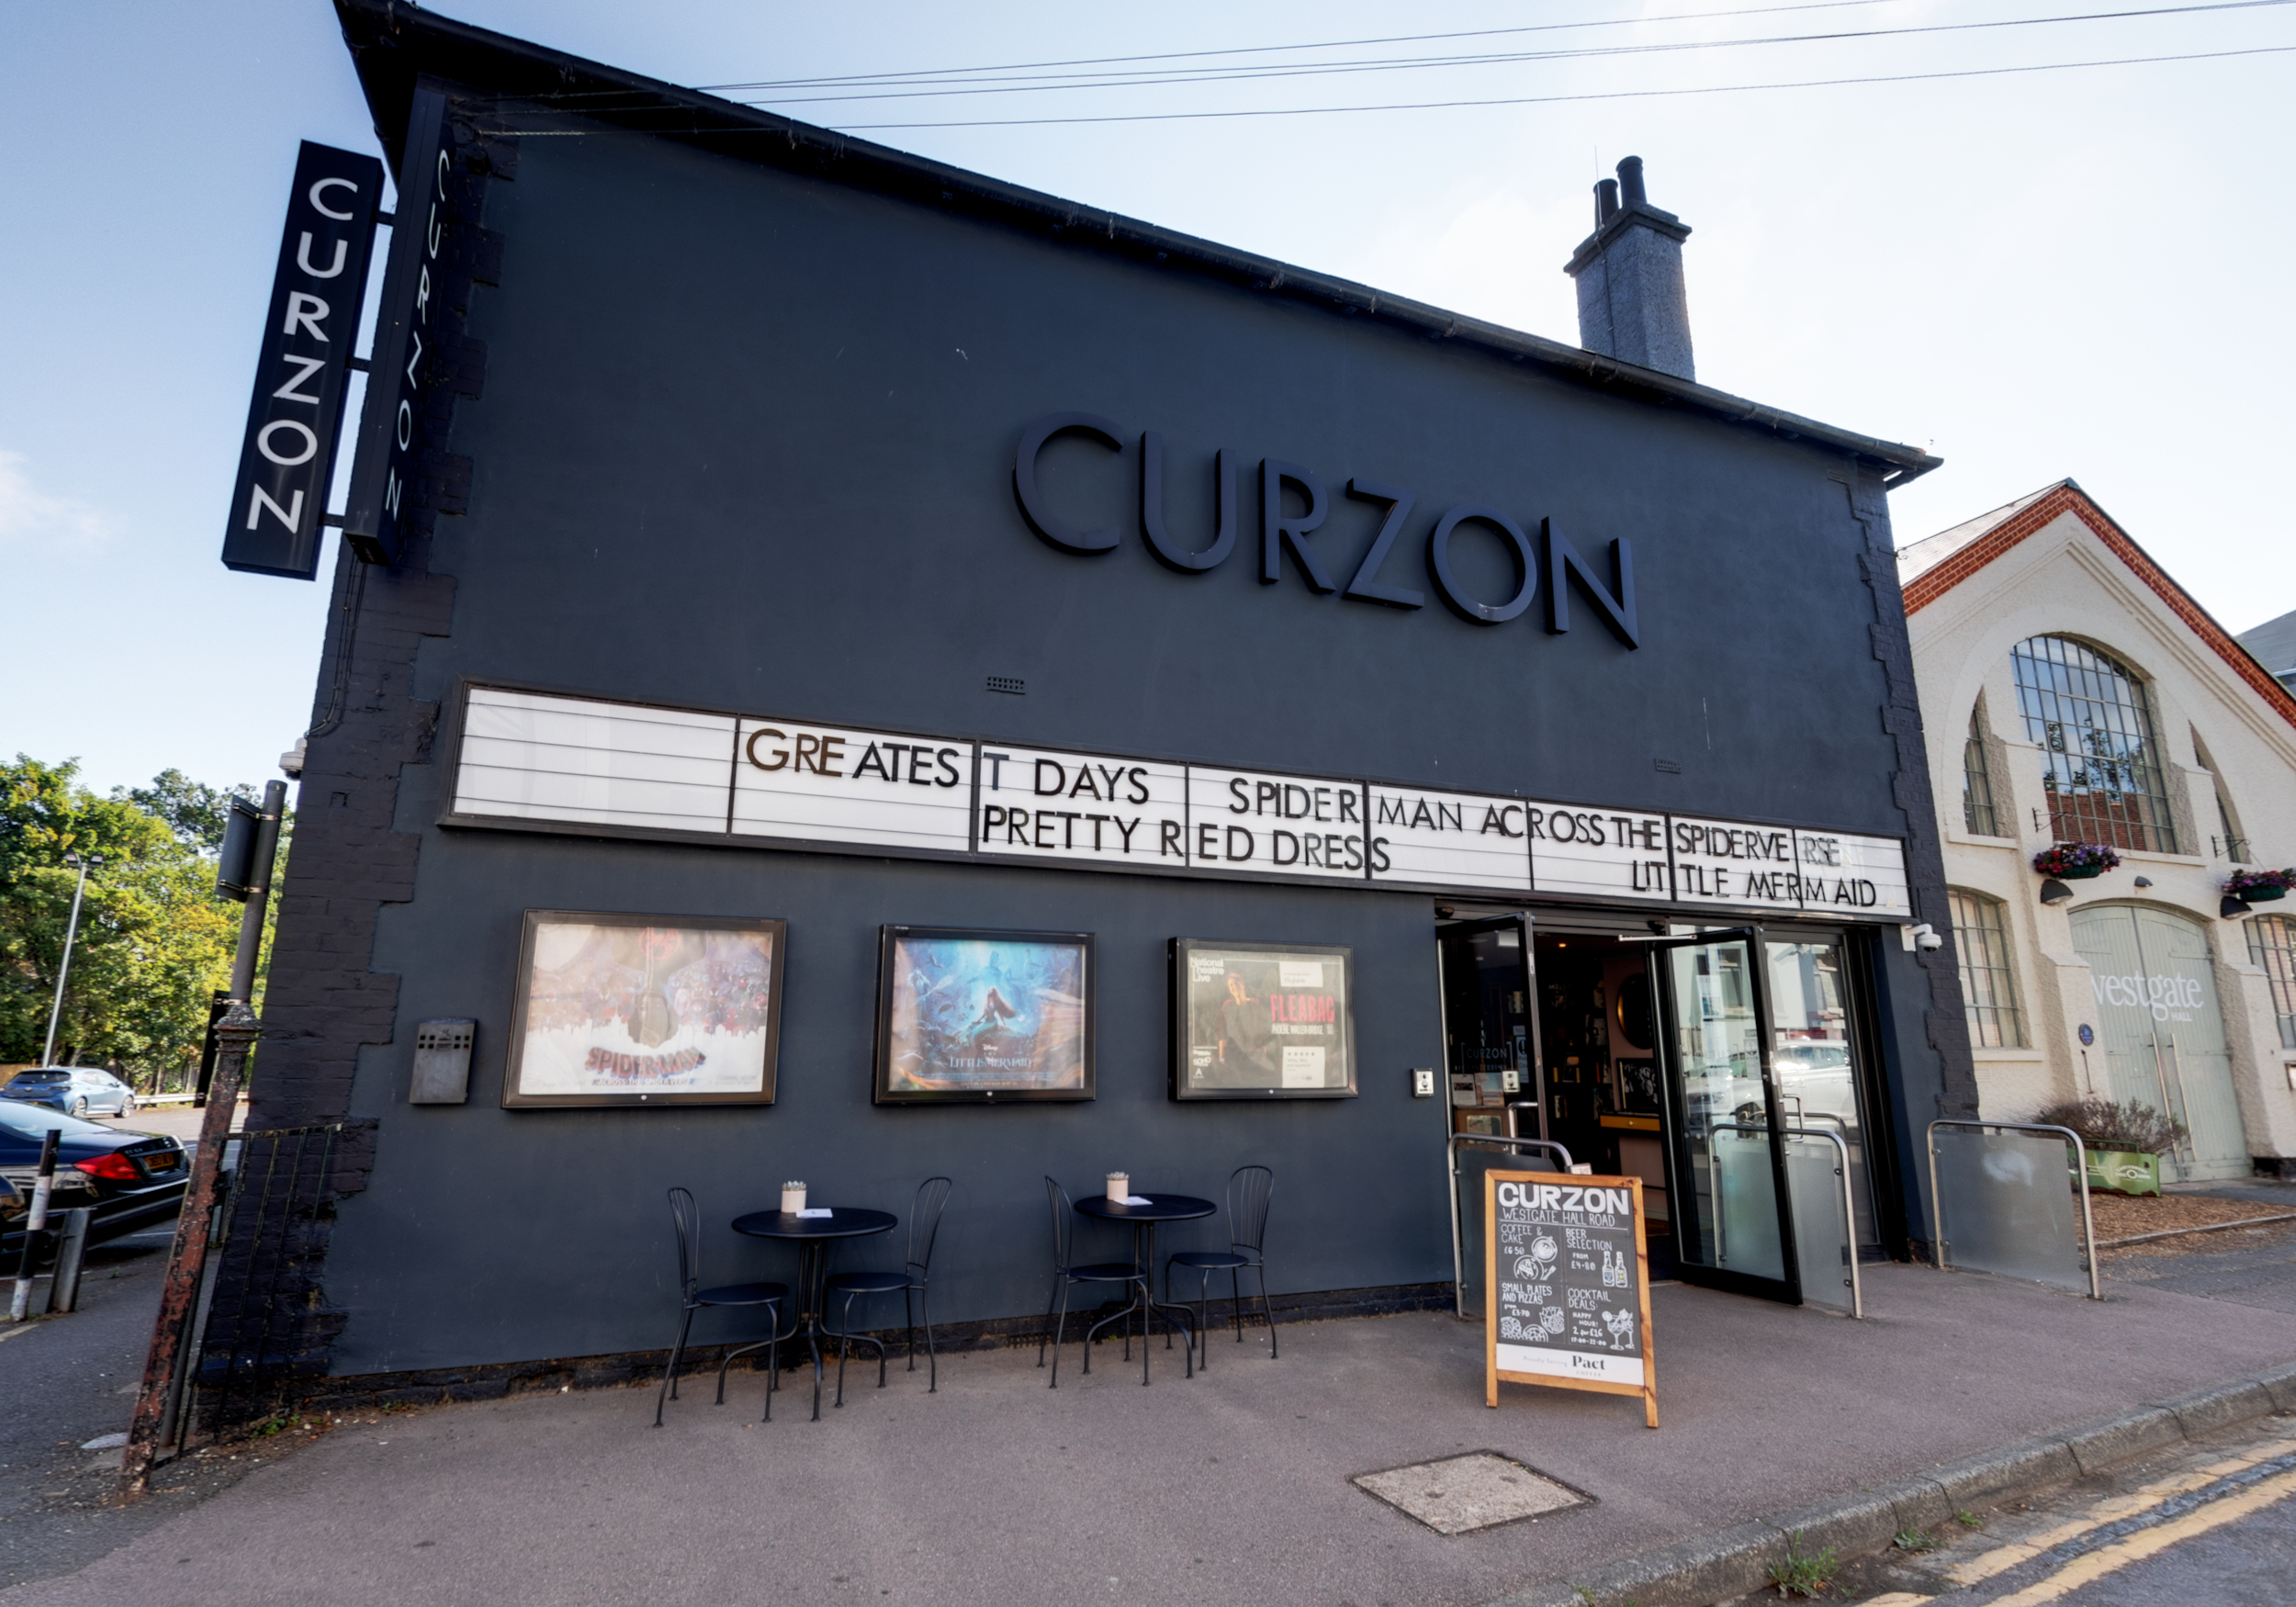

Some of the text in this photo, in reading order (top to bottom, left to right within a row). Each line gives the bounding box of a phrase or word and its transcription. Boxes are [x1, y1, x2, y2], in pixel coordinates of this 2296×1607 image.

[386, 150, 450, 522] CURZON
[246, 177, 358, 534] CURZON
[1012, 410, 1639, 652] CURZON
[1034, 758, 1150, 805] DAYS
[1229, 777, 1361, 824] SPIDER
[1378, 793, 1462, 833] MAN
[1480, 804, 1605, 847] ACROSS
[1610, 816, 1663, 851] THE
[983, 804, 1142, 854] PRETTY
[1161, 818, 1255, 862] RED
[1272, 829, 1392, 872] DRESS
[1190, 957, 1224, 967] National
[1191, 966, 1224, 975] Theatre
[1192, 974, 1211, 983] Live
[1269, 994, 1335, 1023] FLEABAG
[1466, 1047, 1508, 1060] CURZON
[585, 1045, 706, 1079] SPIDER-MAN
[1498, 1182, 1629, 1216] CURZON
[1503, 1208, 1615, 1227] WESTGATE HALL ROAD
[1501, 1223, 1543, 1236] COFFEE &
[1565, 1228, 1587, 1239] BEER
[1501, 1233, 1524, 1245] CAKE
[1566, 1238, 1613, 1252] SELECTION
[1572, 1252, 1589, 1260] FROM
[1502, 1282, 1552, 1297] SMALL PLATES
[1567, 1287, 1612, 1302] COCKTAIL
[1502, 1292, 1544, 1305] AND PIZZAS
[1572, 1311, 1592, 1320] HAPPY
[1572, 1326, 1579, 1335] 2
[1589, 1328, 1604, 1338] £16
[1571, 1354, 1605, 1370] Pact
